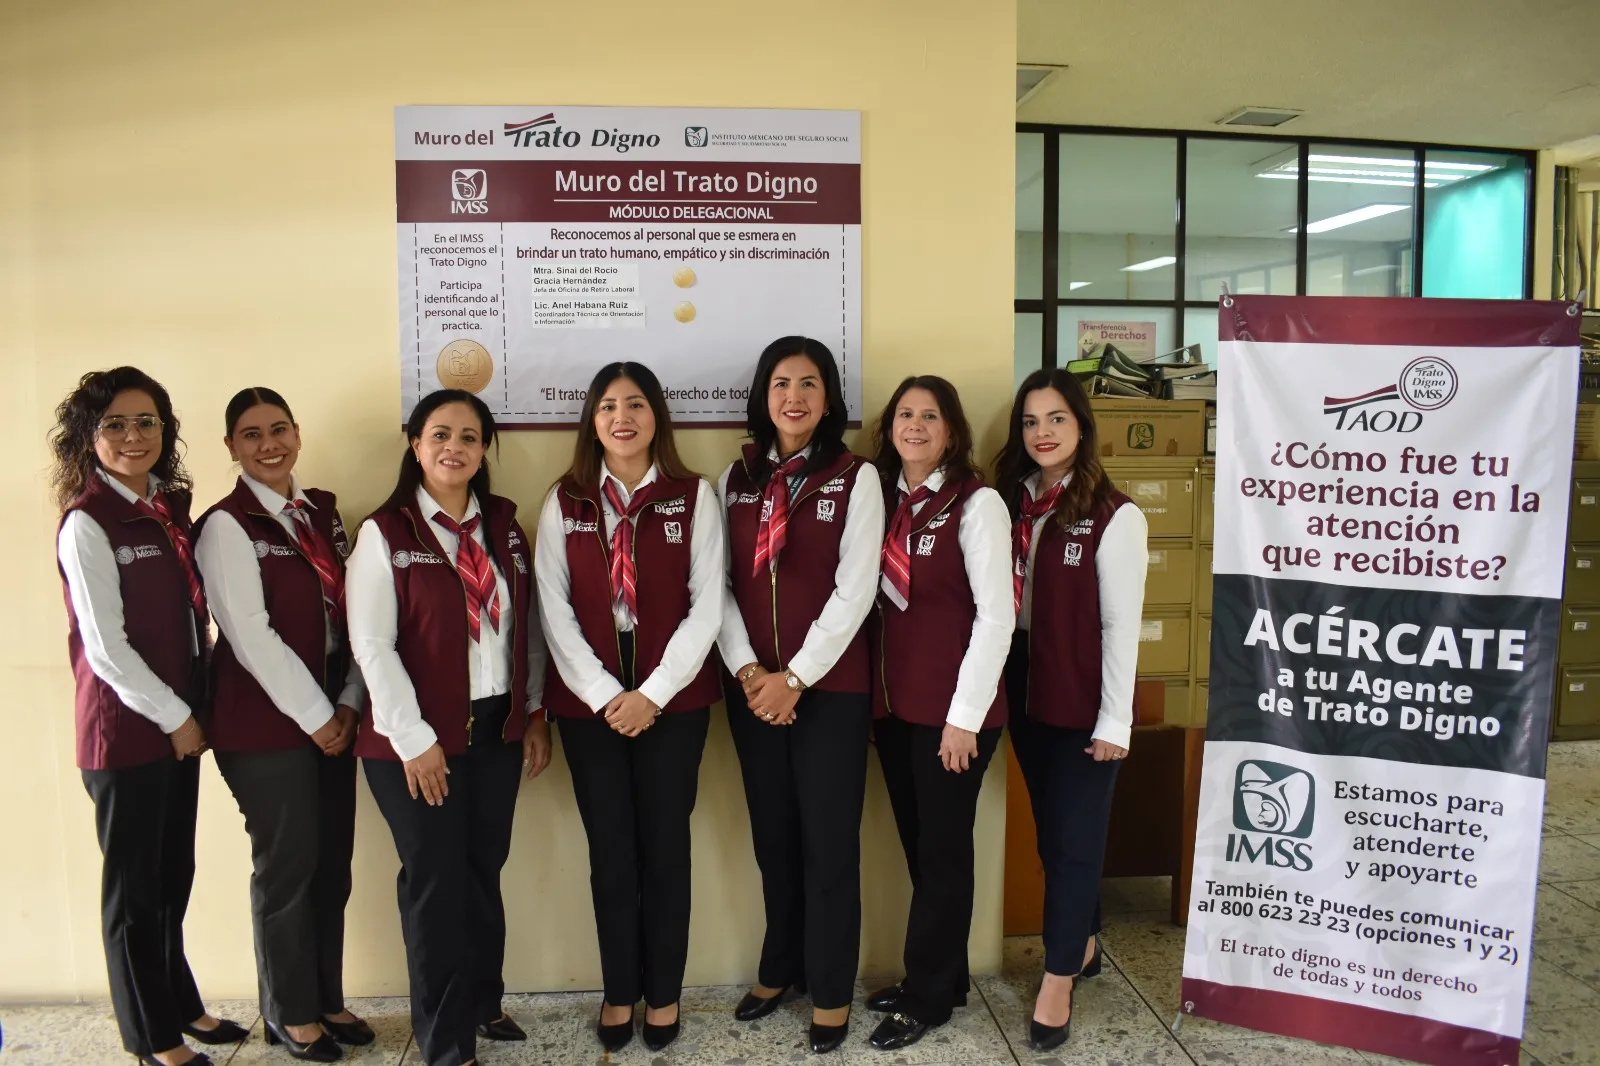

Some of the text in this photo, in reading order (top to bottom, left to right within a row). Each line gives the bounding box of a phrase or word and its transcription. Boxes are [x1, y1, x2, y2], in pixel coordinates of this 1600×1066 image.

[414, 119, 660, 153] Muro del Trato Digno
[556, 170, 818, 199] Muro del Trato Digno
[451, 201, 488, 214] IMSS
[610, 204, 773, 220] MÓDULO DELEGACIONAL
[434, 234, 484, 243] En el IMSS
[489, 245, 497, 254] el
[550, 228, 796, 243] Reconocemos al personal que se esmera en
[430, 258, 487, 269] Trato Digno
[516, 246, 830, 262] brindar un trato humano, empático y sin discriminación
[424, 294, 498, 303] identificando al
[440, 281, 482, 292] Participa
[425, 308, 498, 319] personal que lo
[442, 321, 482, 332] practica.
[1101, 331, 1147, 340] Derechos
[1412, 378, 1445, 388] Digno
[1415, 367, 1444, 376] Trato
[558, 389, 587, 400] trato
[662, 387, 708, 399] derecho
[712, 387, 726, 399] de
[729, 386, 749, 399] tod
[1414, 389, 1442, 399] IMSS
[1324, 404, 1423, 433] TAOD
[1270, 442, 1509, 477] ¿Cómo fue tu
[1240, 477, 1540, 513] experiencia en la
[1307, 513, 1460, 544] atención
[1262, 544, 1507, 581] que recibiste?
[1244, 606, 1526, 672] ACÉRCATE
[1277, 667, 1473, 704] a tu Agente
[1258, 689, 1500, 740] de Trato Digno
[1334, 781, 1504, 817] Estamos para
[1344, 810, 1489, 842] escucharte,
[1225, 833, 1314, 872] IMSS
[1353, 833, 1475, 862] atenderte
[1344, 860, 1478, 889] y apoyarte
[1205, 880, 1515, 942] También te puedes comunicar
[1198, 899, 1519, 966] al 800 623 23 23 (opciones 1 y 2)
[1220, 938, 1478, 995] El trato digno es un derecho
[1273, 963, 1422, 1002] de todas y todos
